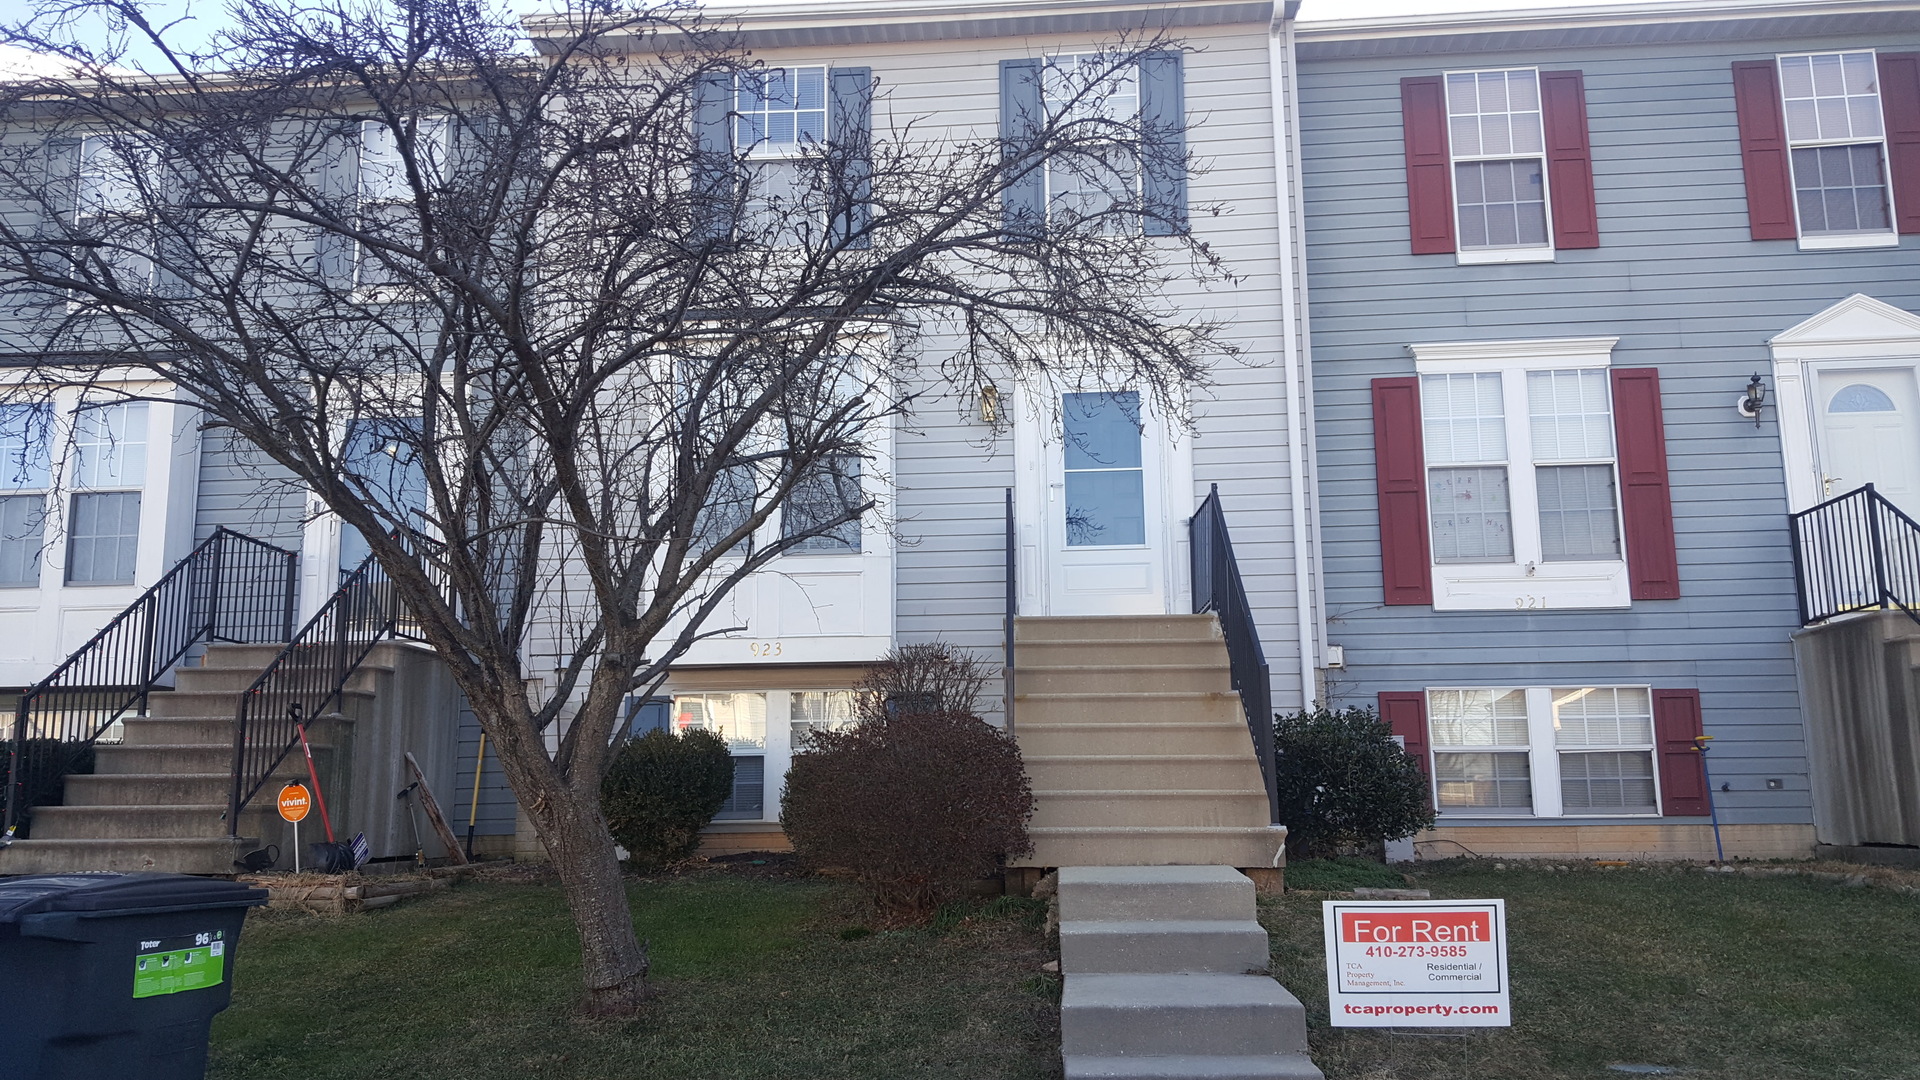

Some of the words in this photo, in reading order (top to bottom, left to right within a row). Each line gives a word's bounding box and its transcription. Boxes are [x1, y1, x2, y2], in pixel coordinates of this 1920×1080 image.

[1515, 596, 1546, 610] 921
[750, 642, 783, 657] 923
[1354, 919, 1402, 942] For
[1411, 919, 1480, 942] Rent
[140, 940, 161, 951] Toter
[195, 932, 209, 946] 96
[1365, 945, 1467, 958] 410-273-9585
[1346, 962, 1363, 970] TCA
[1426, 962, 1477, 971] Residential
[1346, 971, 1375, 979] Property
[1428, 973, 1482, 981] Commercial
[1347, 979, 1392, 987] Management,
[1393, 979, 1406, 987] Inc.
[1344, 1003, 1498, 1017] tcaproperty.com
